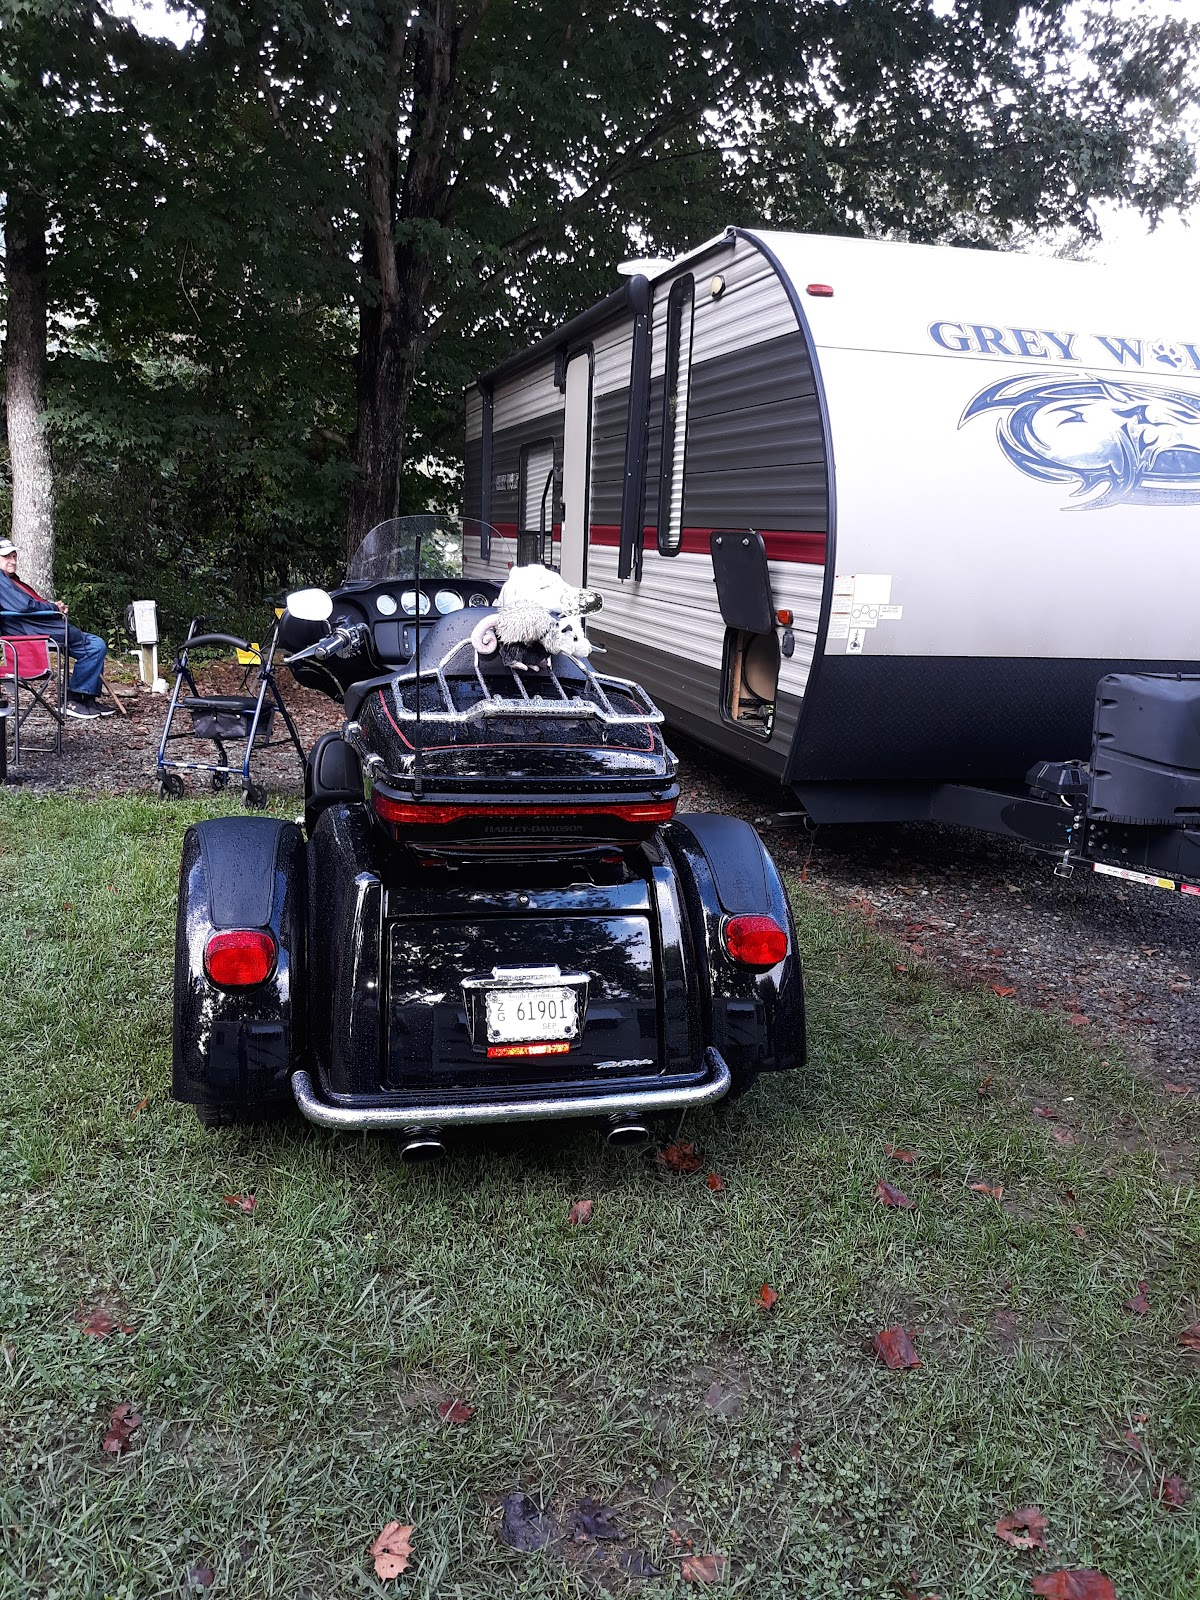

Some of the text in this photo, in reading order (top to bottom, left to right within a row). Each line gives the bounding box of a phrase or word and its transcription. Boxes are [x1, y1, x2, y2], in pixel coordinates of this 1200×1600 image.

[929, 321, 1079, 361] GREY
[484, 825, 584, 833] HARLEY-DAVIDSON
[517, 1000, 567, 1021] 61901
